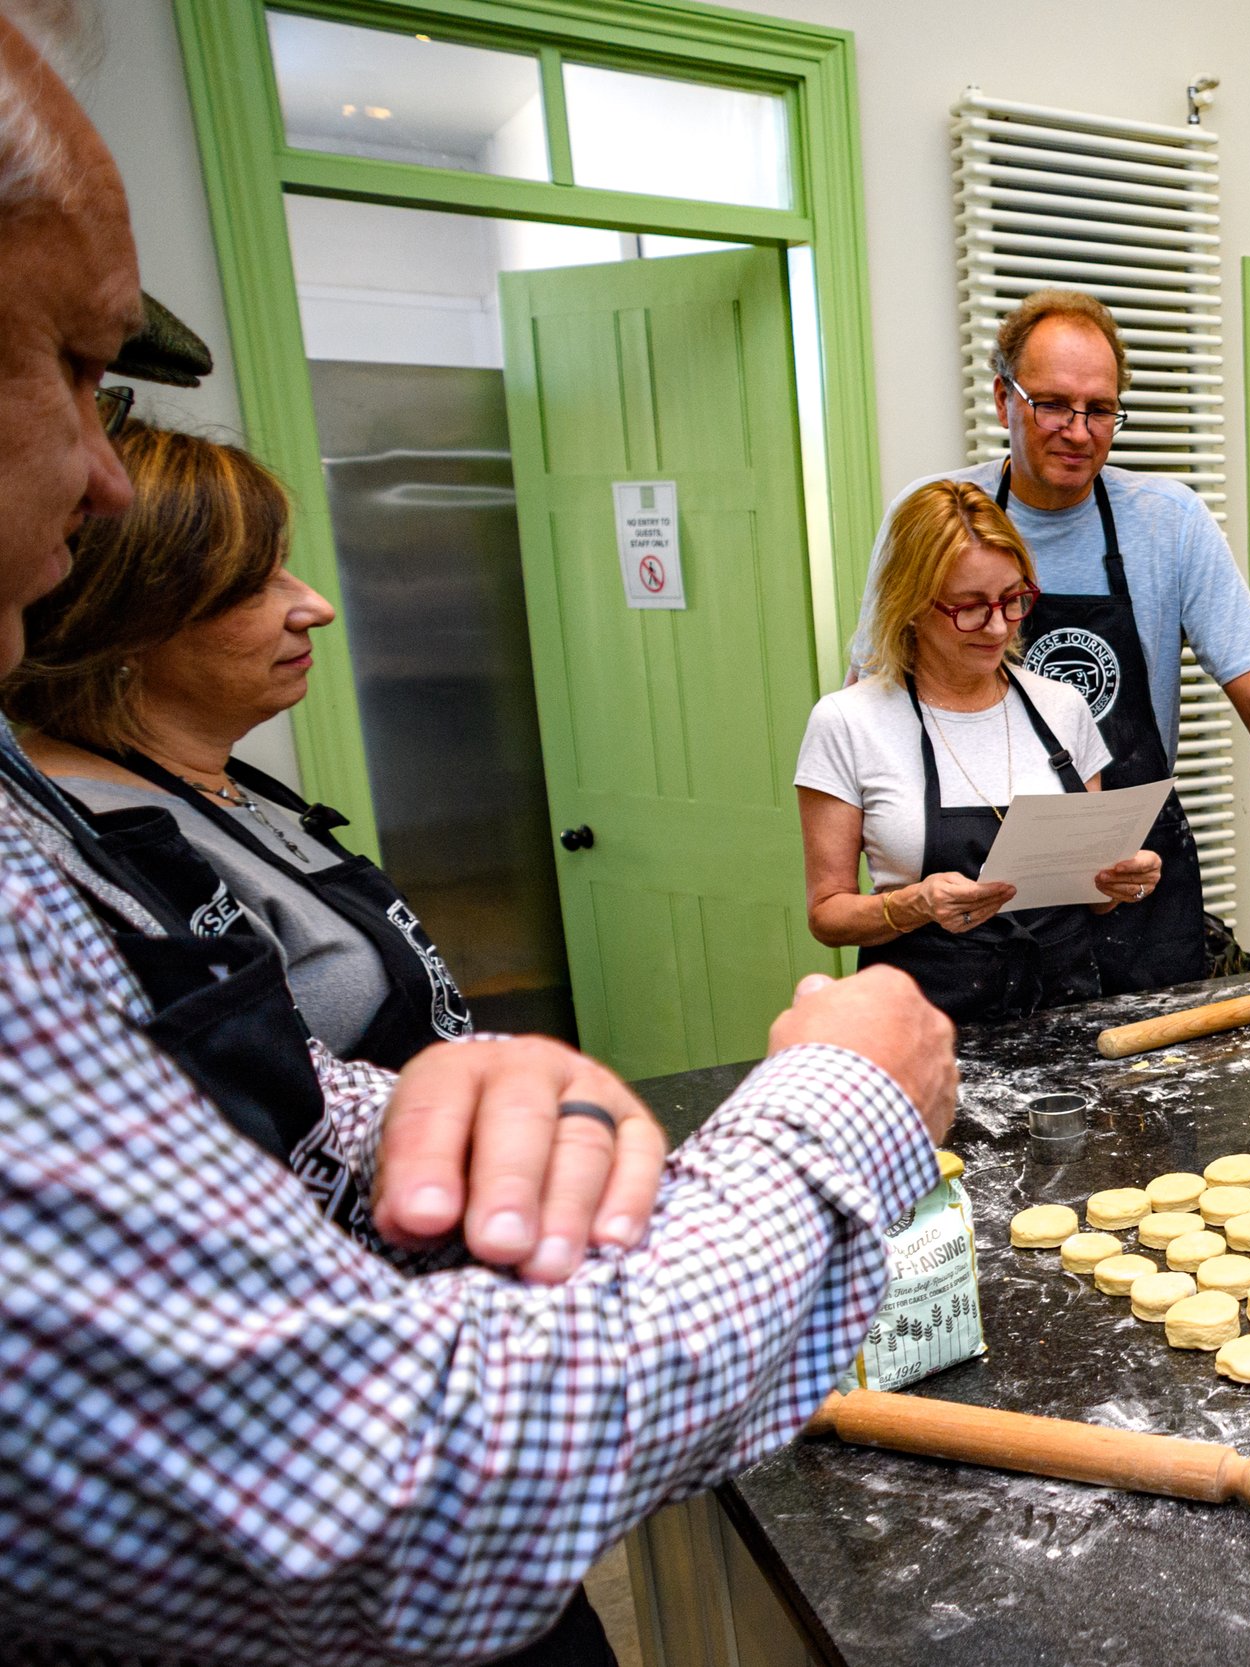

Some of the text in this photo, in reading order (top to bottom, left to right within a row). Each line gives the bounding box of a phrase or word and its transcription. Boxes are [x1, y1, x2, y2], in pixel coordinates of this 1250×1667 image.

[626, 517, 671, 527] NO ENTRY TO
[630, 539, 669, 549] STAFF ONLY
[1026, 633, 1117, 678] CHEESE JOURNEYS
[897, 1300, 909, 1309] FOR
[928, 1284, 950, 1298] COOKIES
[896, 1361, 922, 1380] 1912
